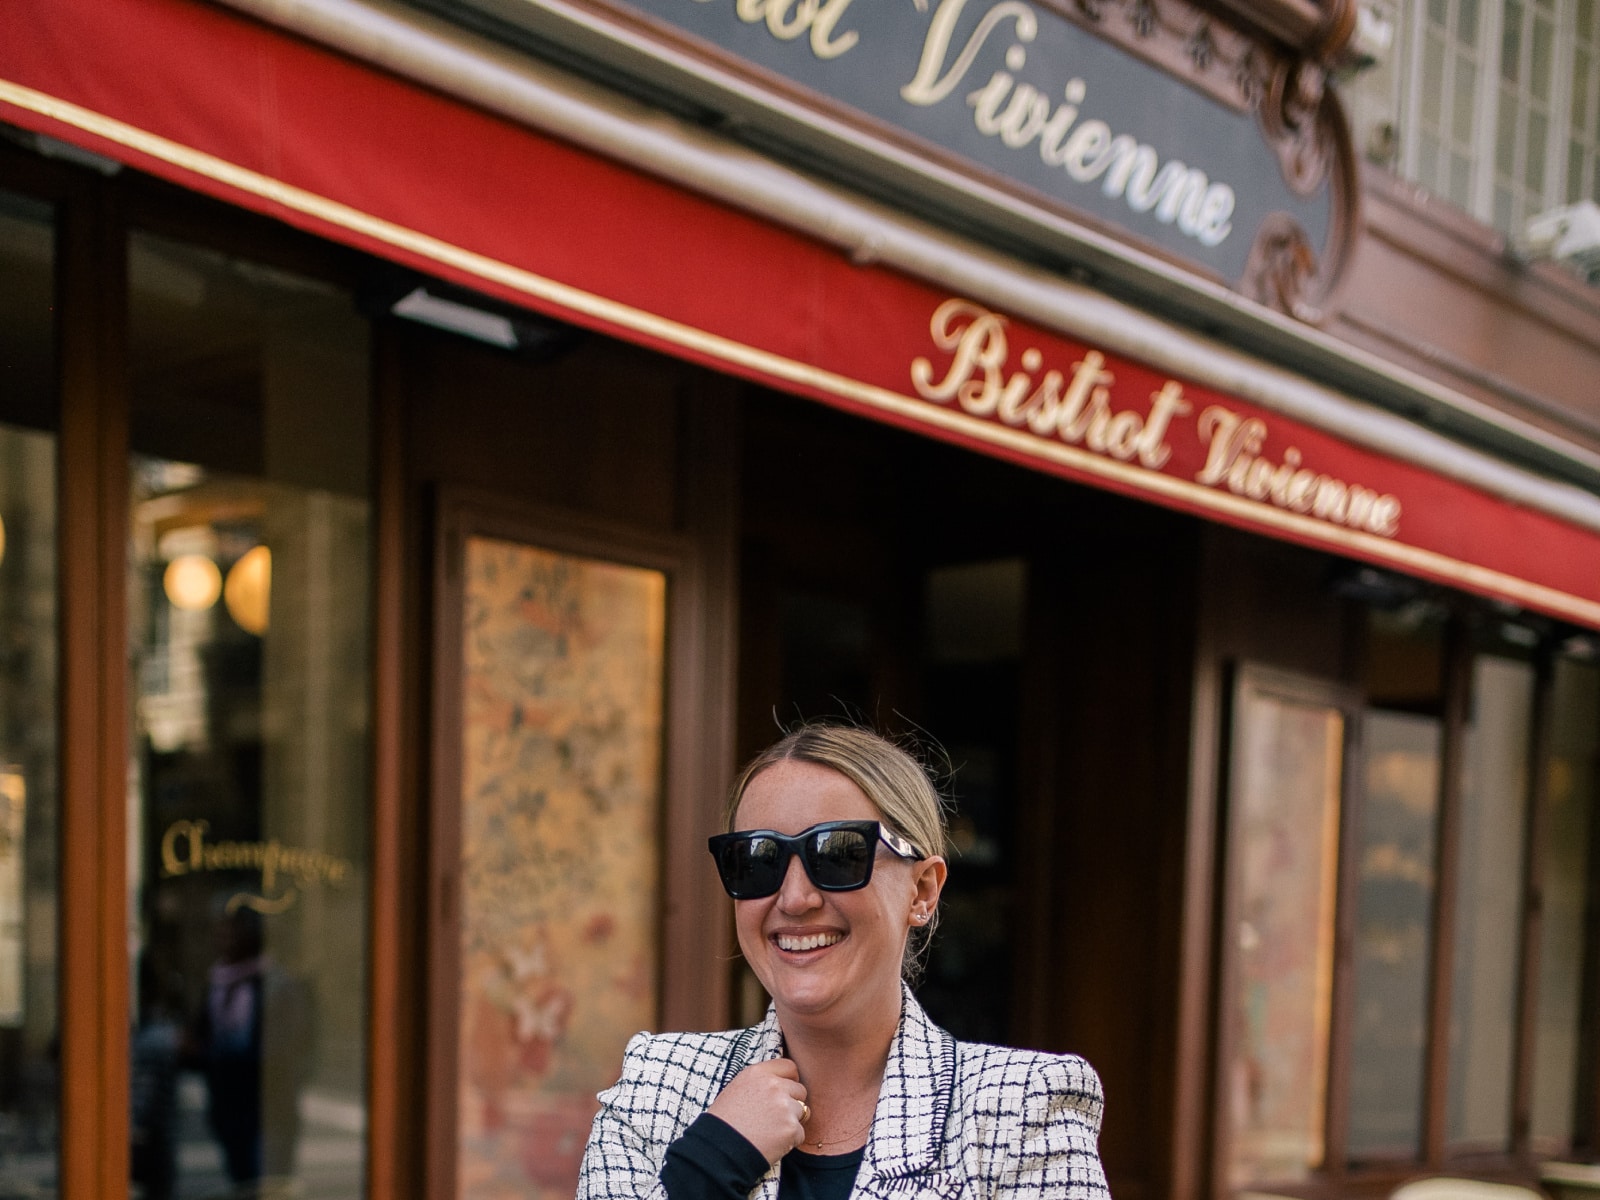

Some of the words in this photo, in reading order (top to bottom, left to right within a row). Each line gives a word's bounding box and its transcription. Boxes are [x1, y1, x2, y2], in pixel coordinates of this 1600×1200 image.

[901, 0, 1236, 247] Vivienne
[910, 298, 1194, 470] Bistrot
[1196, 403, 1401, 537] Vivienne
